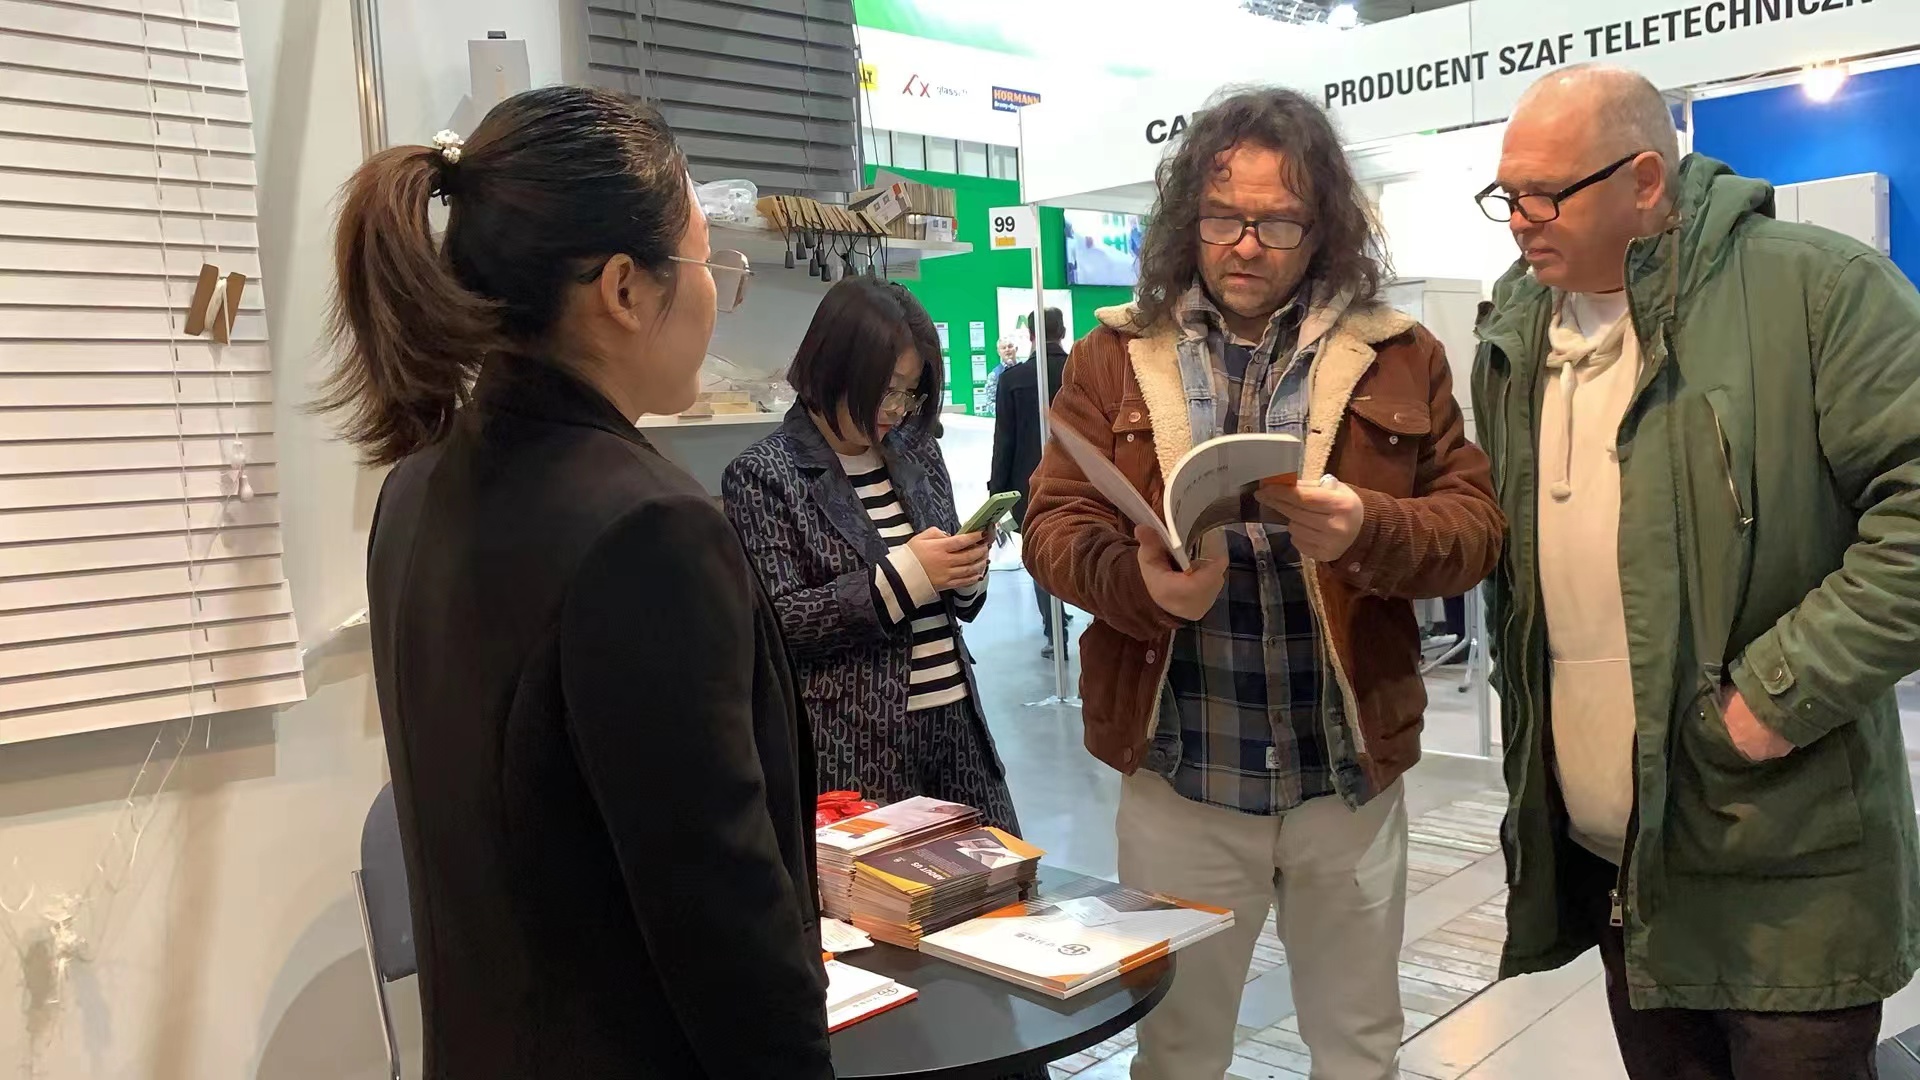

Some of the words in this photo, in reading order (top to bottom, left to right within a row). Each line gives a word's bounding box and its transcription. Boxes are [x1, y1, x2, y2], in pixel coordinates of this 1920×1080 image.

[1145, 111, 1203, 144] CA
[1324, 51, 1490, 109] PRODUCENT
[1499, 33, 1574, 76] SZAF
[994, 215, 1016, 233] 99
[910, 861, 924, 869] US
[919, 867, 946, 880] ABOUT
